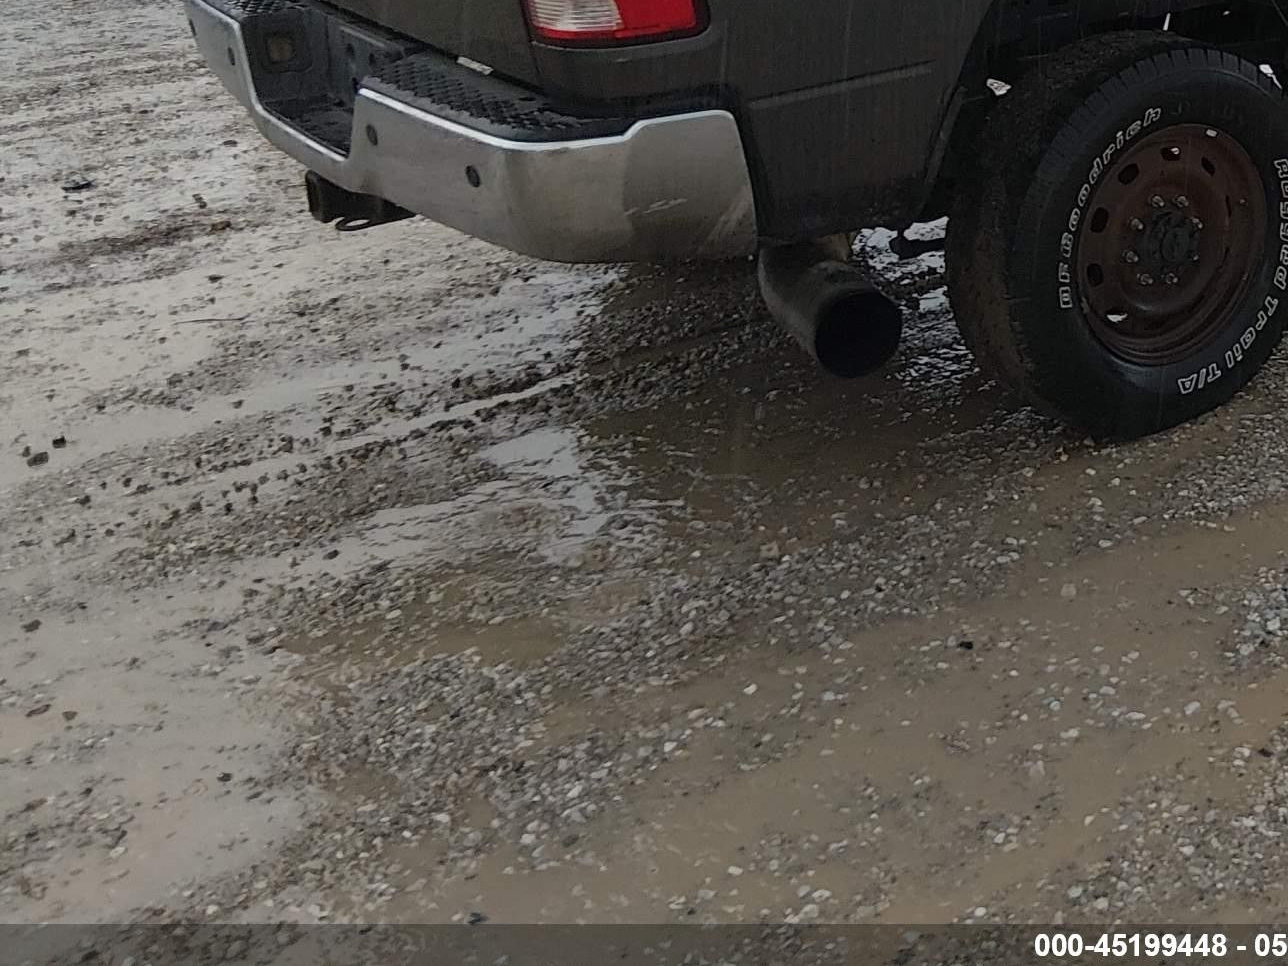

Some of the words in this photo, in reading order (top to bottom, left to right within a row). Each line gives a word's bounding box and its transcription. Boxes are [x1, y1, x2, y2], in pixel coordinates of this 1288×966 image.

[1058, 107, 1161, 309] BFGoodrich
[1224, 295, 1279, 369] Trail
[1177, 362, 1222, 395] T/A
